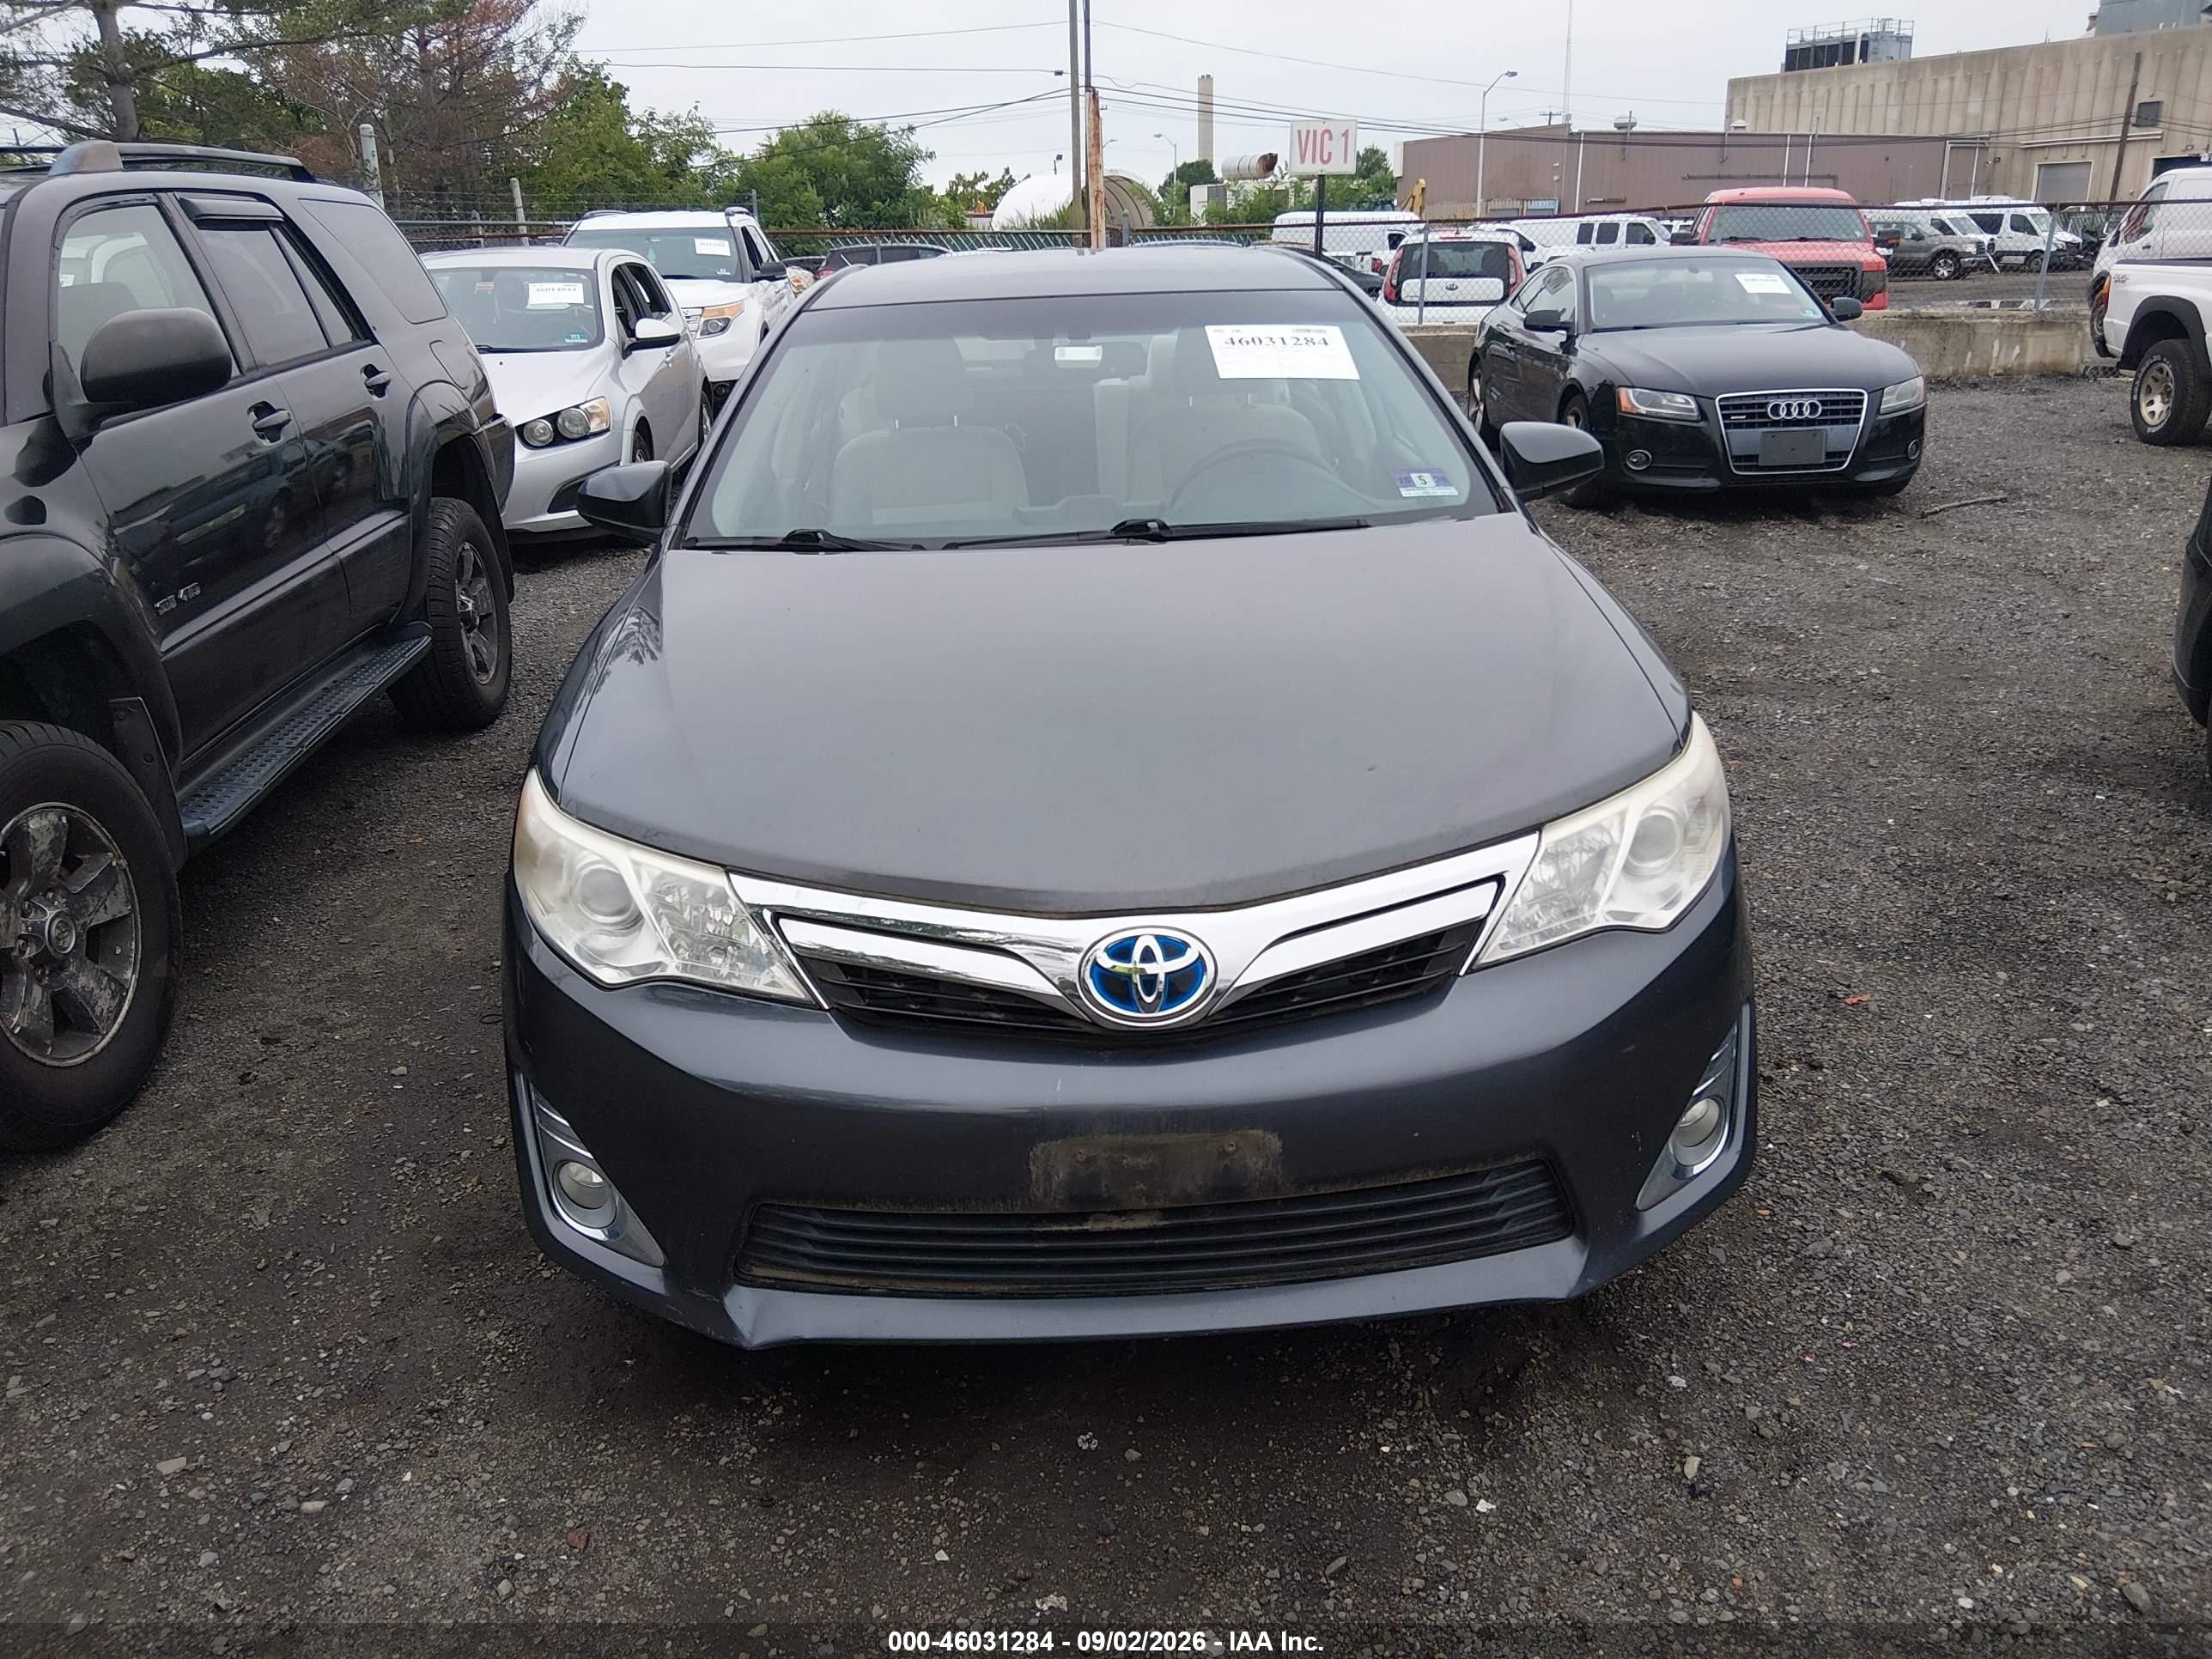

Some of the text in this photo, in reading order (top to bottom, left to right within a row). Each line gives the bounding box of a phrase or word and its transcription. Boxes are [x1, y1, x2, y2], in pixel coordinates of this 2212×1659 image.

[1297, 129, 1350, 165] VIC 1
[1224, 336, 1329, 347] 46031284
[1417, 475, 1428, 486] 5
